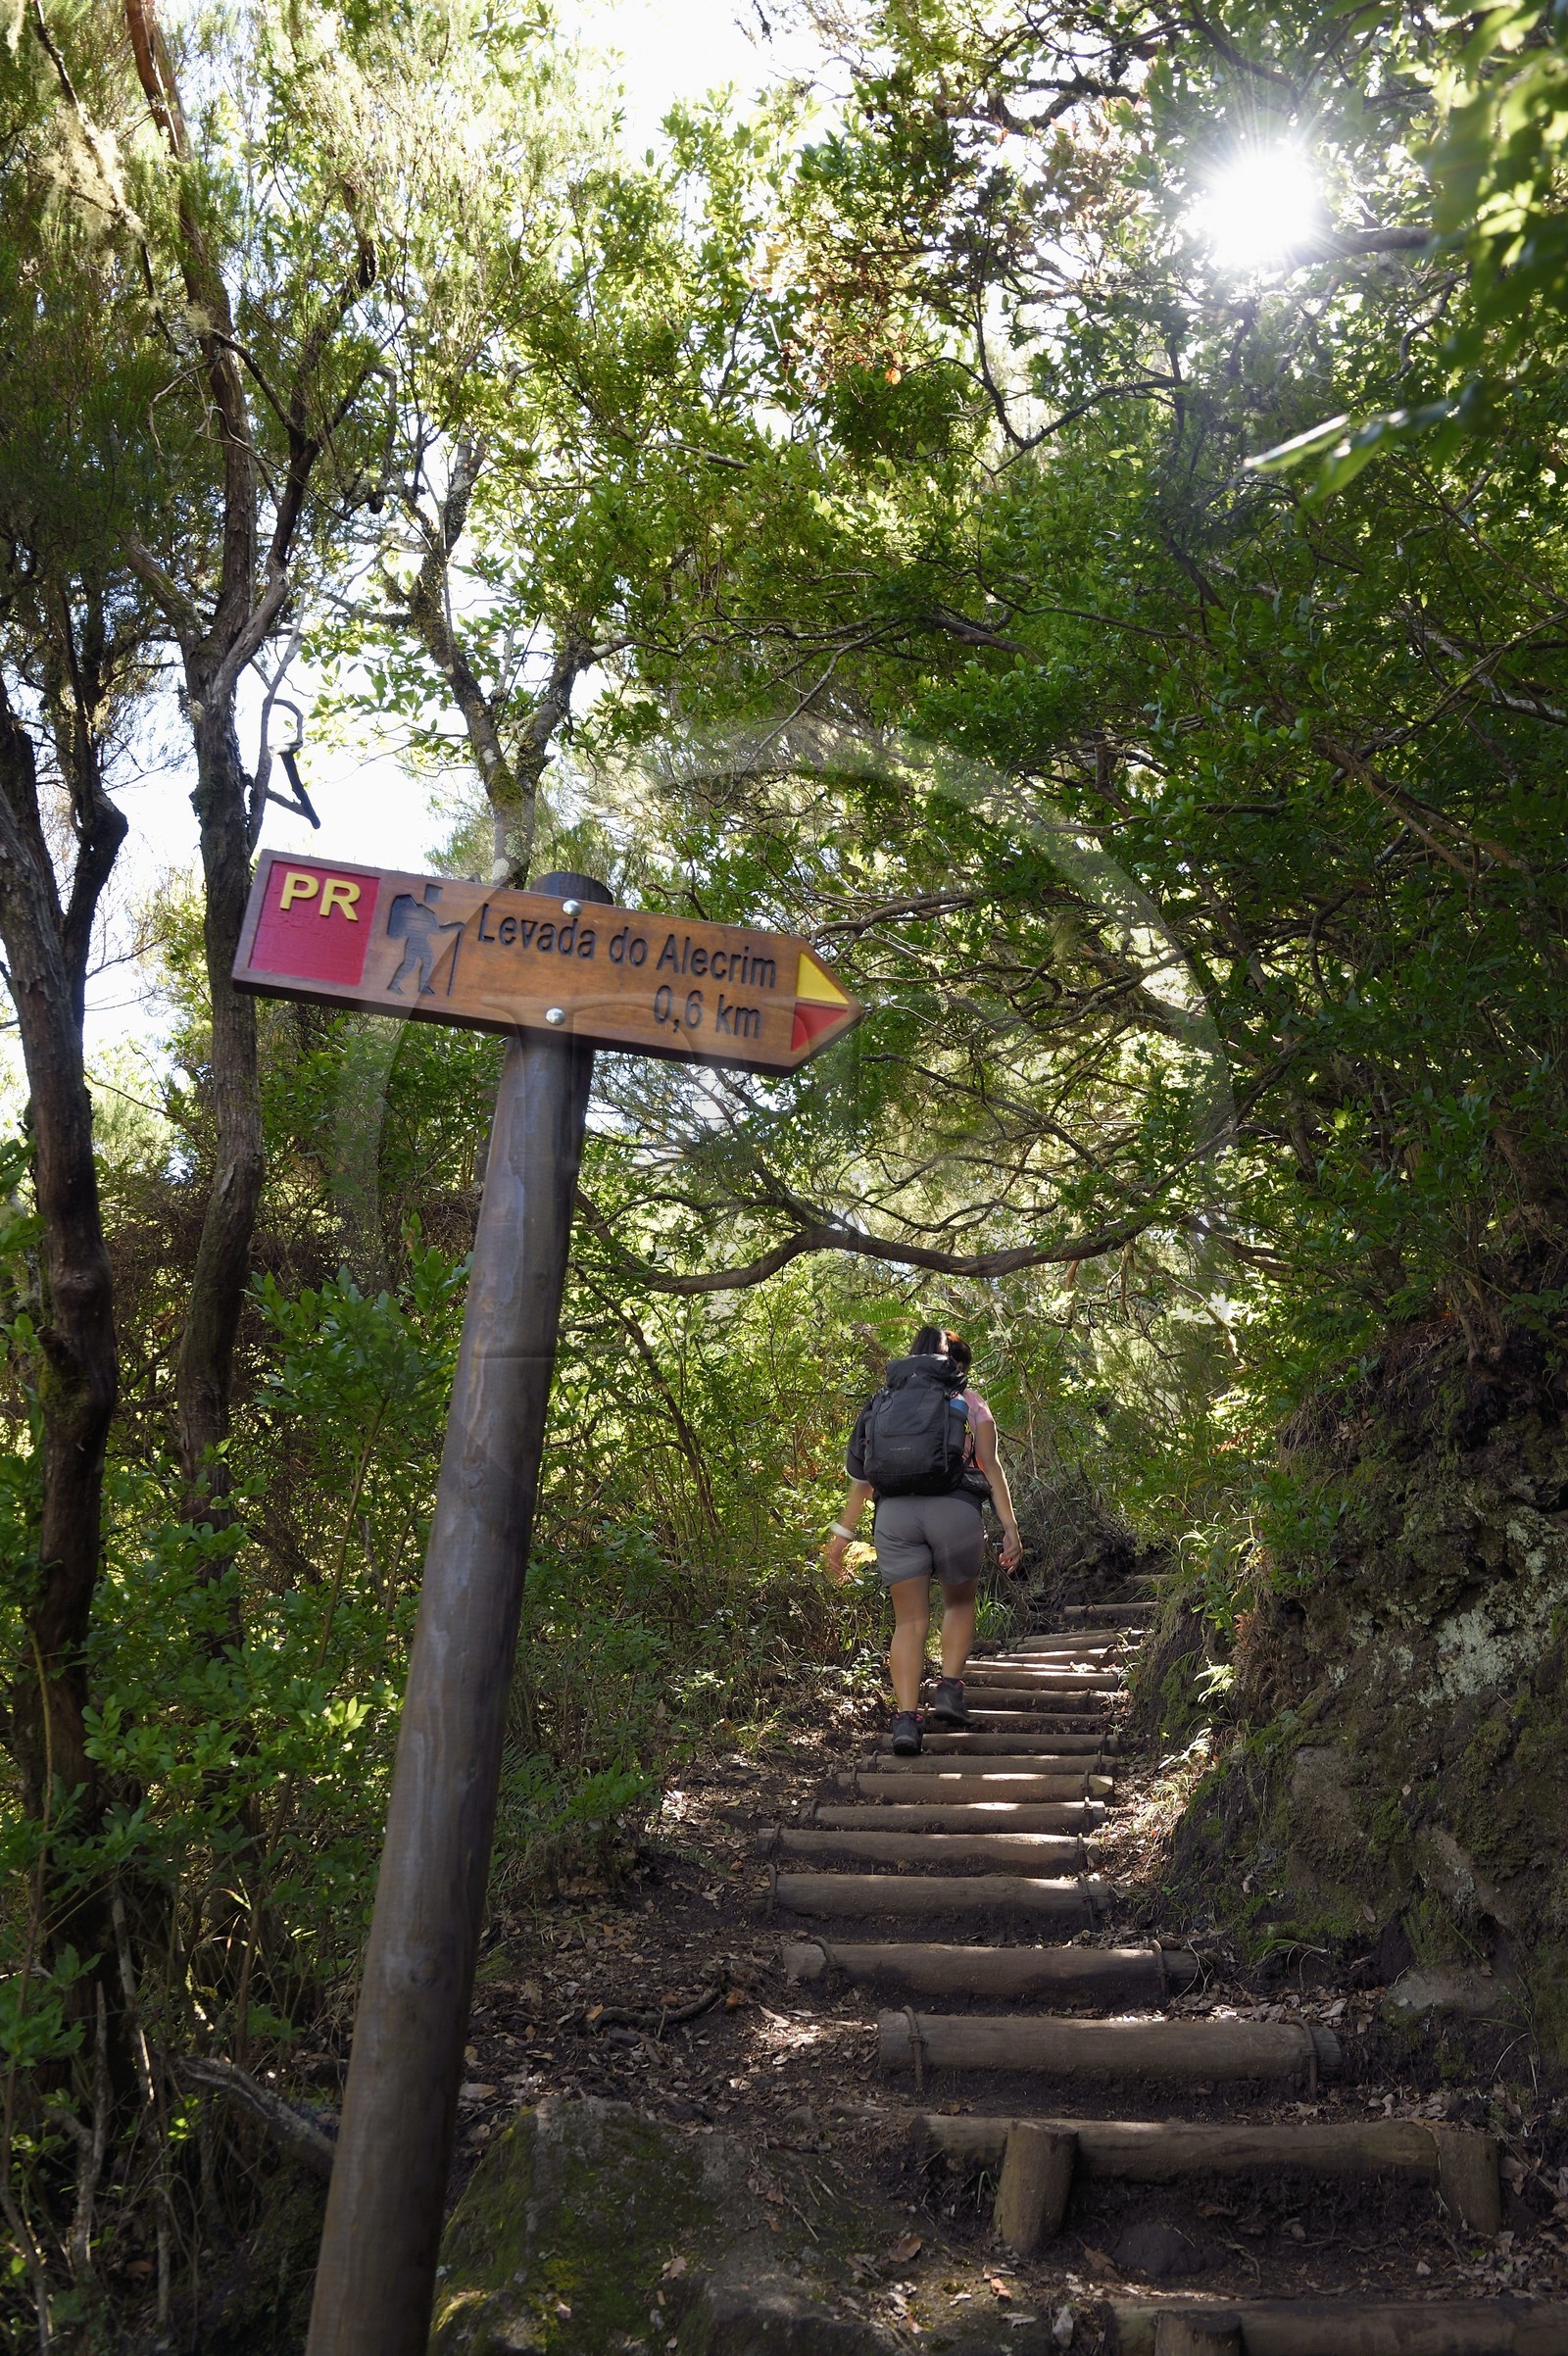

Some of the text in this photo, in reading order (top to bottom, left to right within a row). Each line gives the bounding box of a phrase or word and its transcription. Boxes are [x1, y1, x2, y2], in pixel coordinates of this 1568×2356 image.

[279, 871, 362, 922] PR
[477, 903, 776, 989] Levada do Alecrim
[654, 985, 761, 1039] 0,6 km
